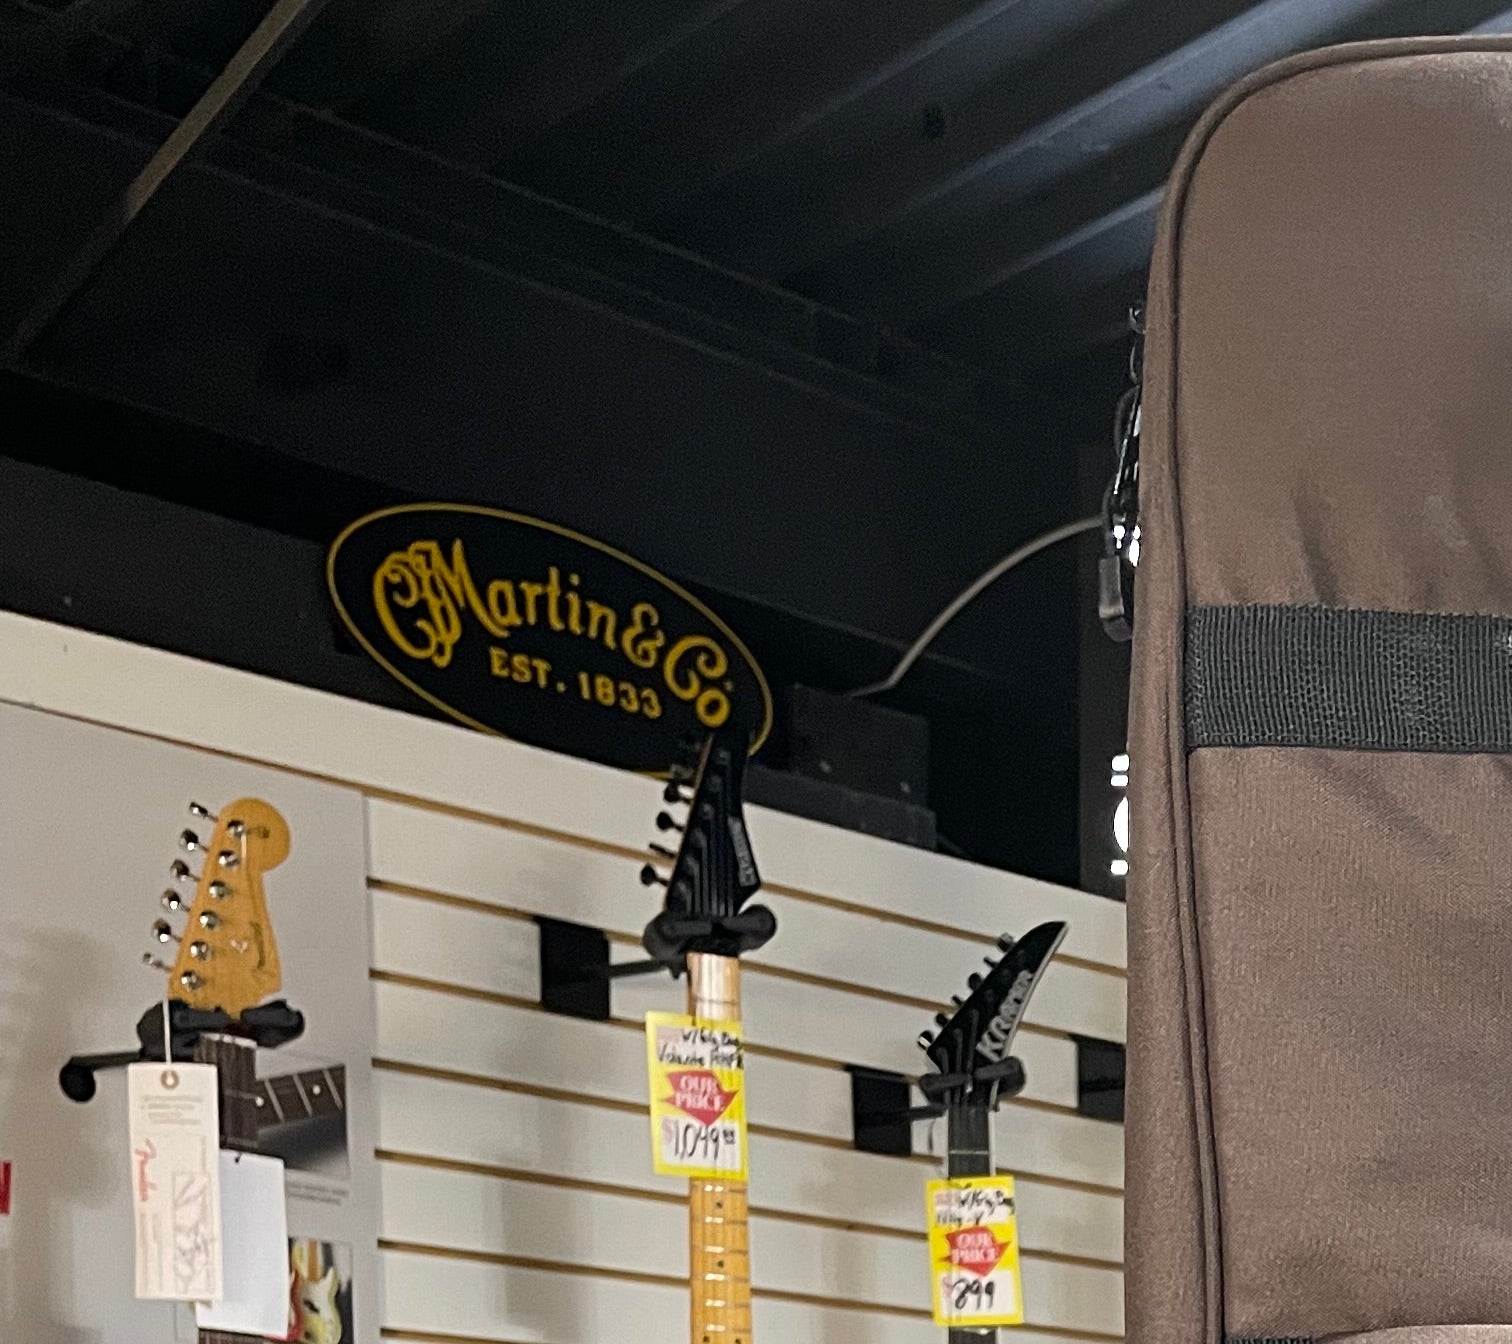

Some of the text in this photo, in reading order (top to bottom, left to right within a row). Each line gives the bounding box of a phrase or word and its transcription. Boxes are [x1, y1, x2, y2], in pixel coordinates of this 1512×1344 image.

[578, 672, 662, 719] 1833
[680, 1074, 719, 1093] OUR
[674, 1090, 723, 1111] PRICE
[956, 1231, 995, 1249] OUR
[950, 1246, 997, 1265] PRICE
